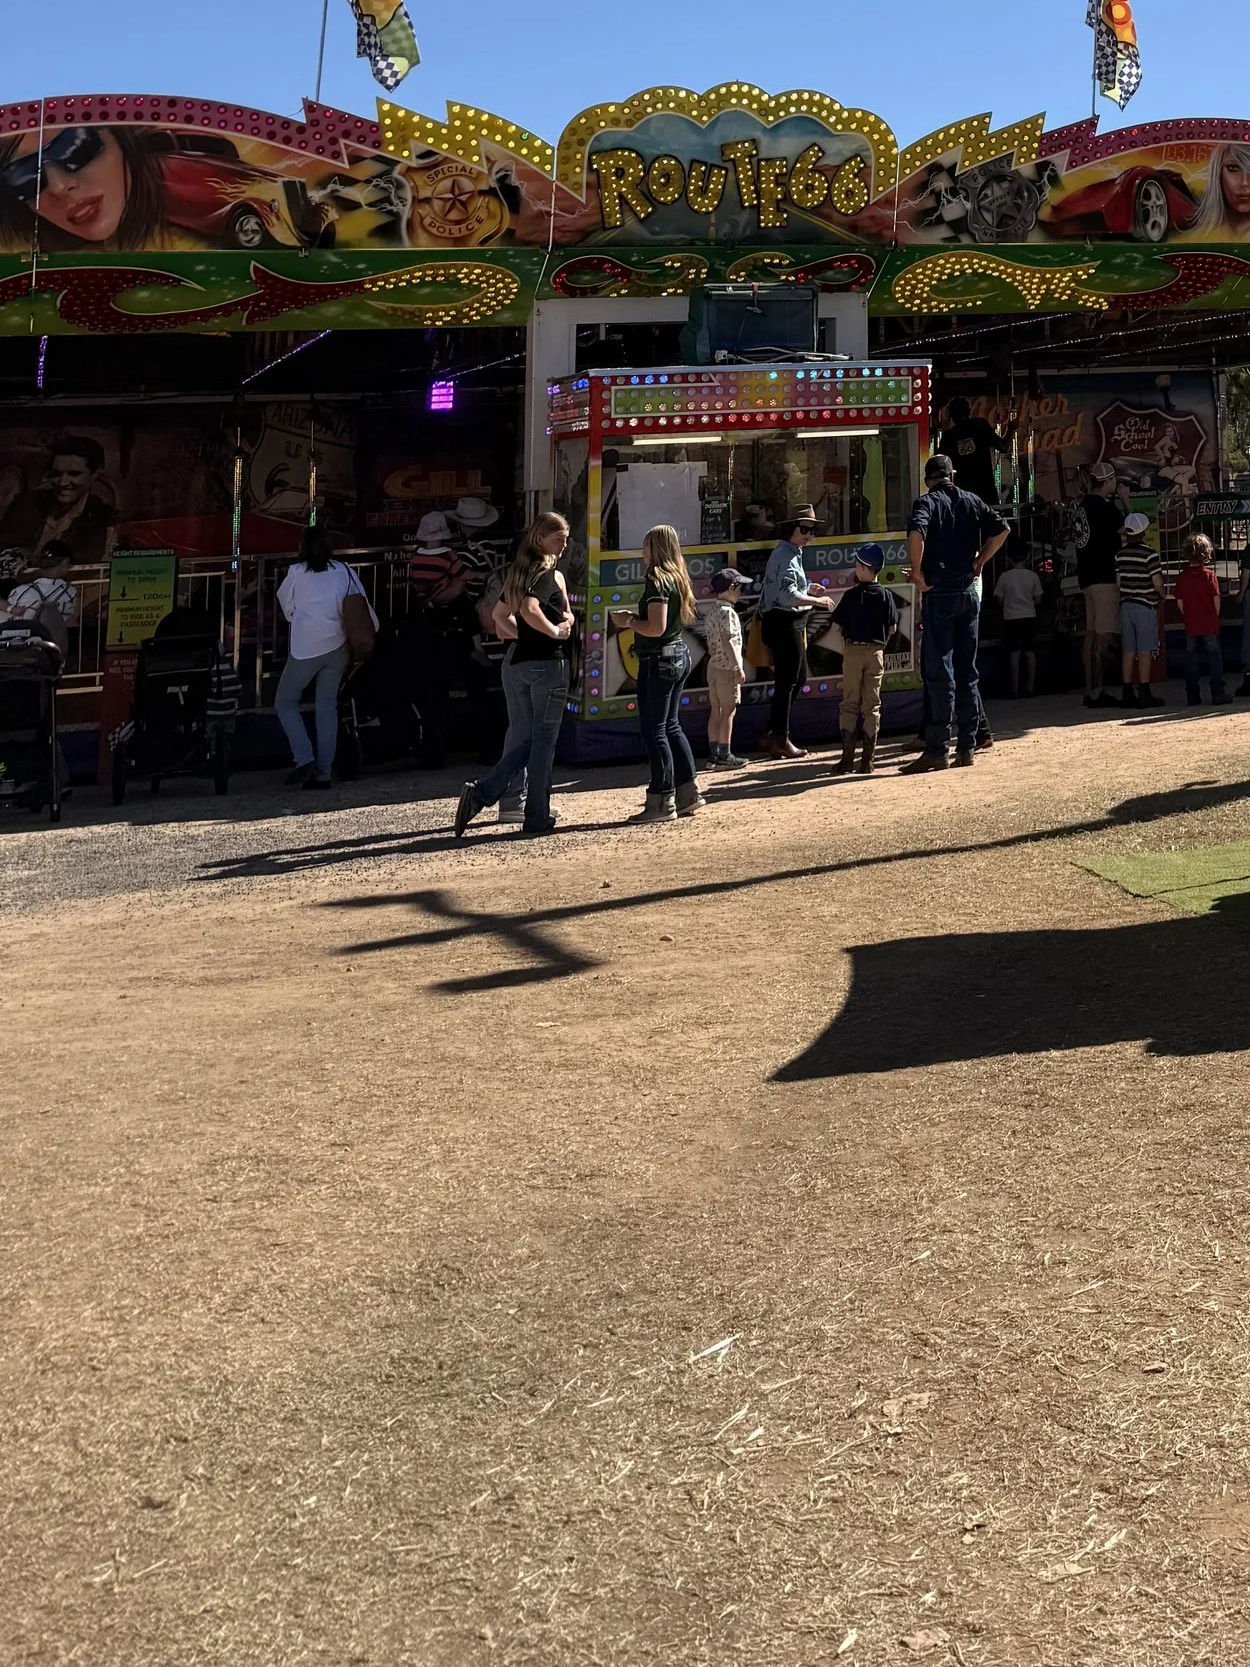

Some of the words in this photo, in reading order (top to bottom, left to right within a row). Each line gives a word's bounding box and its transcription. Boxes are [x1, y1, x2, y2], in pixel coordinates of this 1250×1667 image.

[426, 164, 475, 183] SPECIAL
[588, 138, 788, 230] ROUTE
[788, 142, 869, 217] 66
[427, 214, 485, 236] POLICE
[1126, 417, 1150, 431] Old
[1111, 425, 1155, 443] School
[1120, 439, 1148, 453] Cool
[1196, 500, 1238, 516] ENTRY
[815, 549, 854, 567] ROU
[885, 543, 908, 561] 66
[614, 564, 648, 582] GIL
